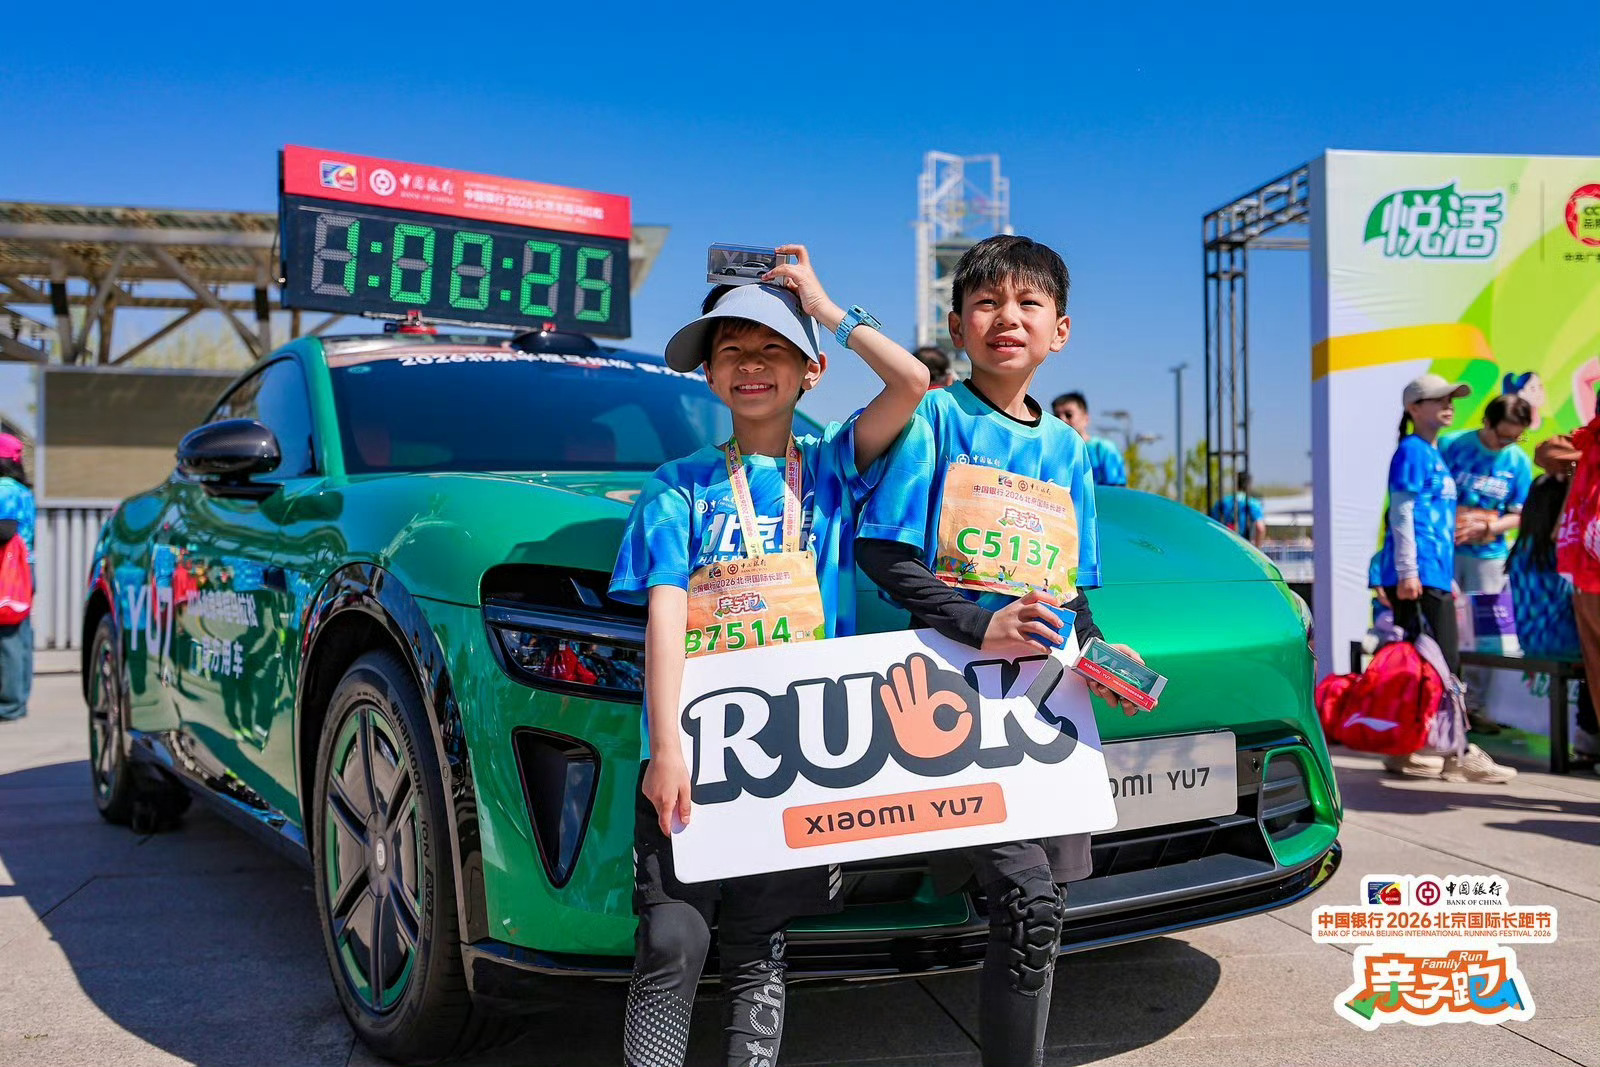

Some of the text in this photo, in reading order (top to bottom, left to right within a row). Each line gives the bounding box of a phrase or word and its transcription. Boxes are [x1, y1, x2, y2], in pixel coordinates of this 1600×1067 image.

[1377, 190, 1504, 259] 悦活
[343, 219, 611, 323] 1:00:25
[956, 527, 1060, 570] C5137
[127, 585, 173, 657] YU7
[685, 616, 791, 654] B7514
[1167, 767, 1210, 791] YU7
[931, 796, 983, 818] YU7
